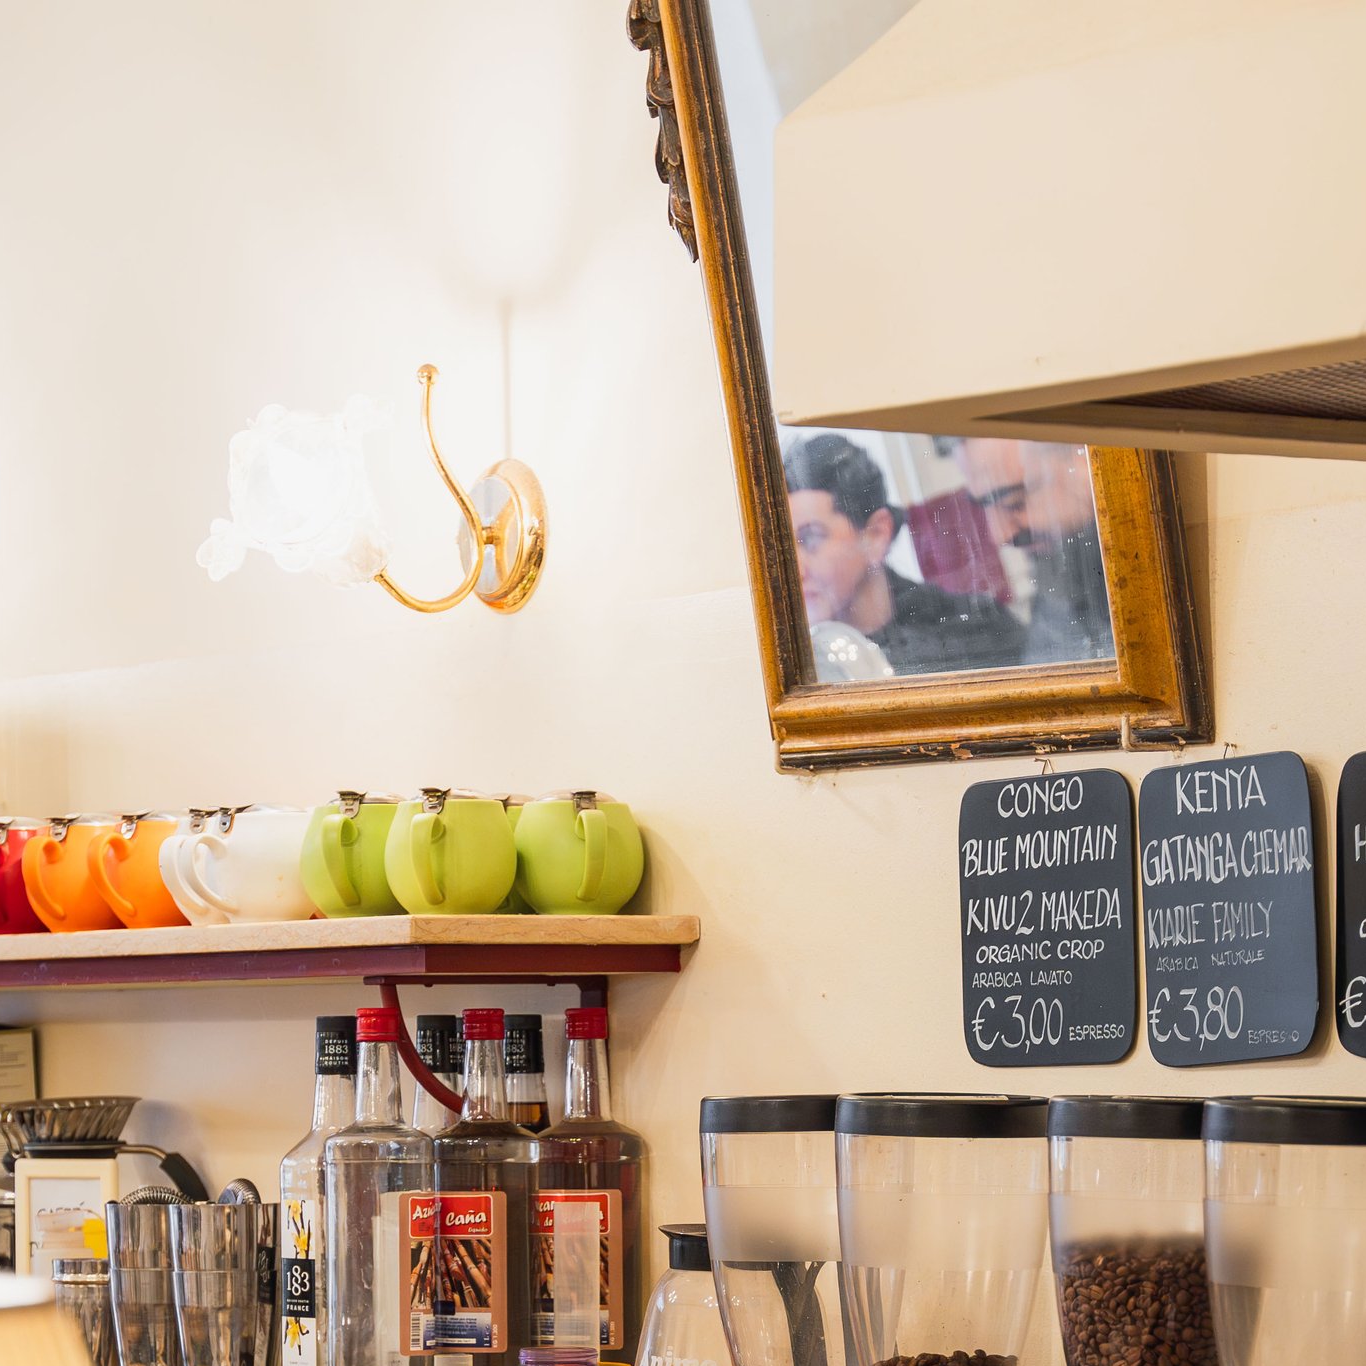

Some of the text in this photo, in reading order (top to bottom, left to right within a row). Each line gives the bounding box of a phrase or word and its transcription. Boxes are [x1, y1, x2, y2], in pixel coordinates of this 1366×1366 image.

[997, 776, 1084, 819] CONGO
[1176, 765, 1267, 815] KENYA
[962, 824, 1117, 878] BLUE MOUNTAIN
[1143, 826, 1312, 886] GATANGA CHEMAR
[1040, 887, 1122, 932] MAKEDA
[1148, 900, 1273, 949] KIARIE FAMILY
[976, 939, 1104, 964] ORGANIC CROP
[1156, 949, 1265, 973] ARABICA NATURALE
[972, 970, 1072, 989] ARABICA LAVATO
[1069, 1024, 1125, 1041] ESPRESSO
[1248, 1029, 1299, 1044] ESPRESO
[325, 1045, 348, 1054] 1883
[445, 1211, 487, 1226] Caña
